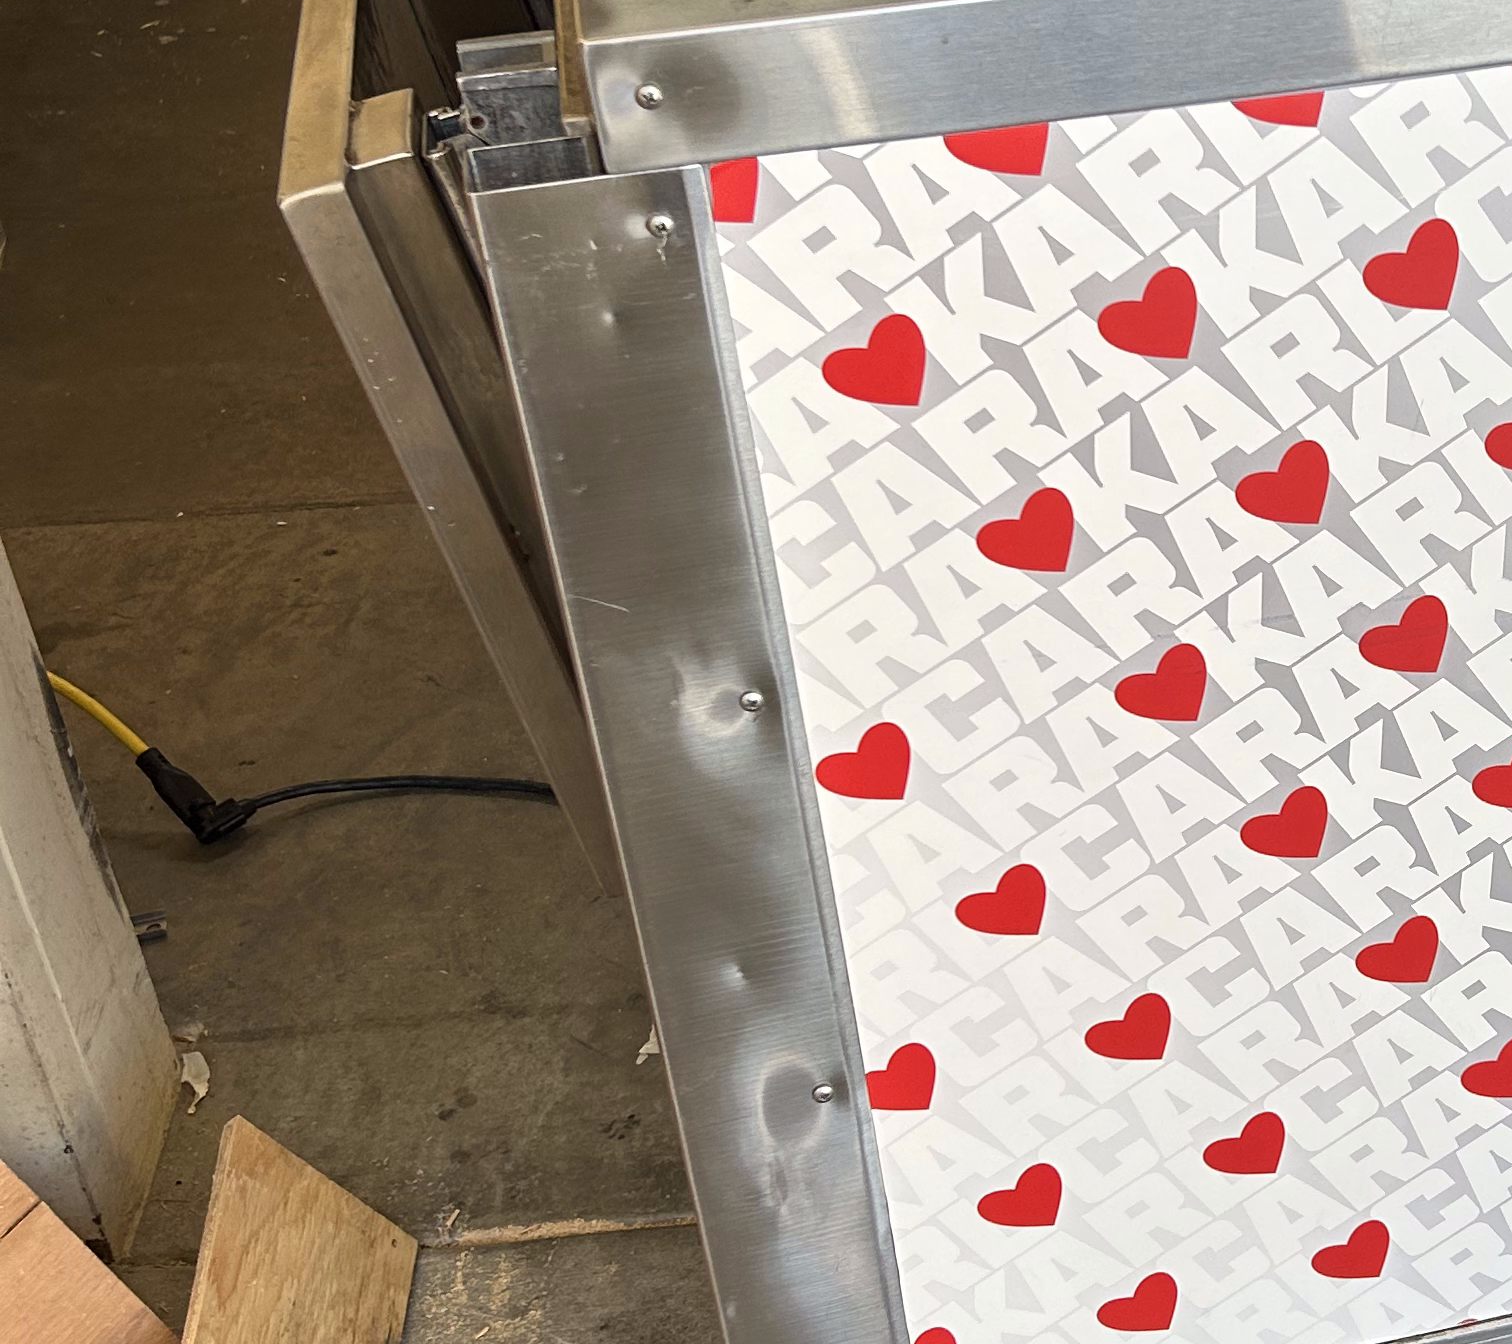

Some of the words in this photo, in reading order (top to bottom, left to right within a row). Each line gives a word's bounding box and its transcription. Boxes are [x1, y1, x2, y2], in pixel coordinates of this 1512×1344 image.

[794, 530, 1049, 755] RA
[1038, 261, 1449, 556] KARL
[881, 479, 1301, 778] CARA
[846, 905, 1043, 1066] RL
[1020, 632, 1420, 913] CARA
[912, 823, 1302, 1090] CARA
[878, 1031, 1166, 1248] ARL
[893, 1200, 1061, 1324] RL
[1039, 952, 1413, 1203] CARA
